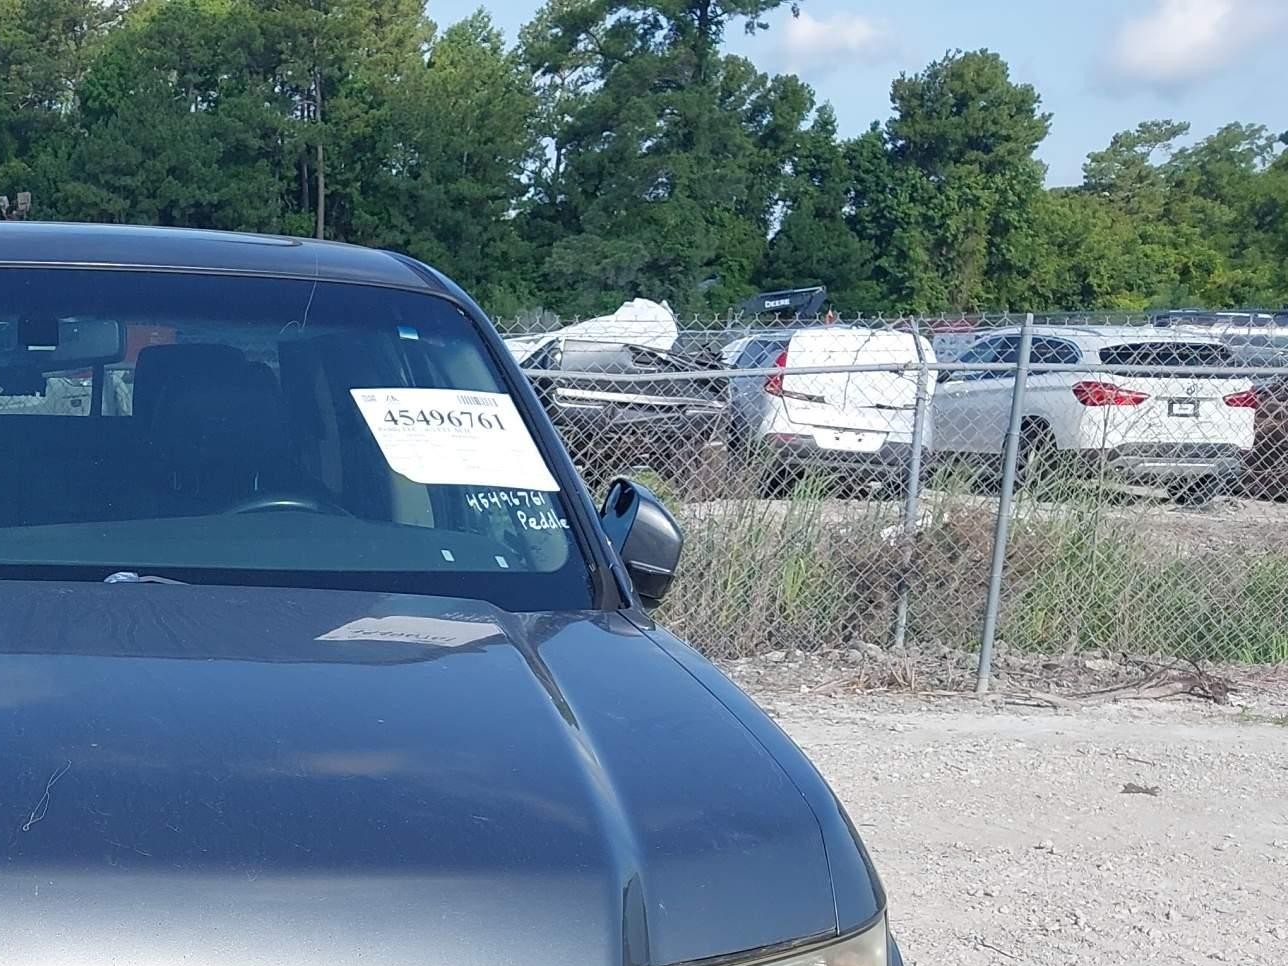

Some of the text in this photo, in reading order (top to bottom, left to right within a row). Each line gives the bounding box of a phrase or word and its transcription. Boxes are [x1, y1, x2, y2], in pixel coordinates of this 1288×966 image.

[765, 299, 790, 308] DEERE
[383, 409, 506, 431] 45496761
[465, 491, 546, 512] 45496761
[517, 508, 570, 530] Peddle
